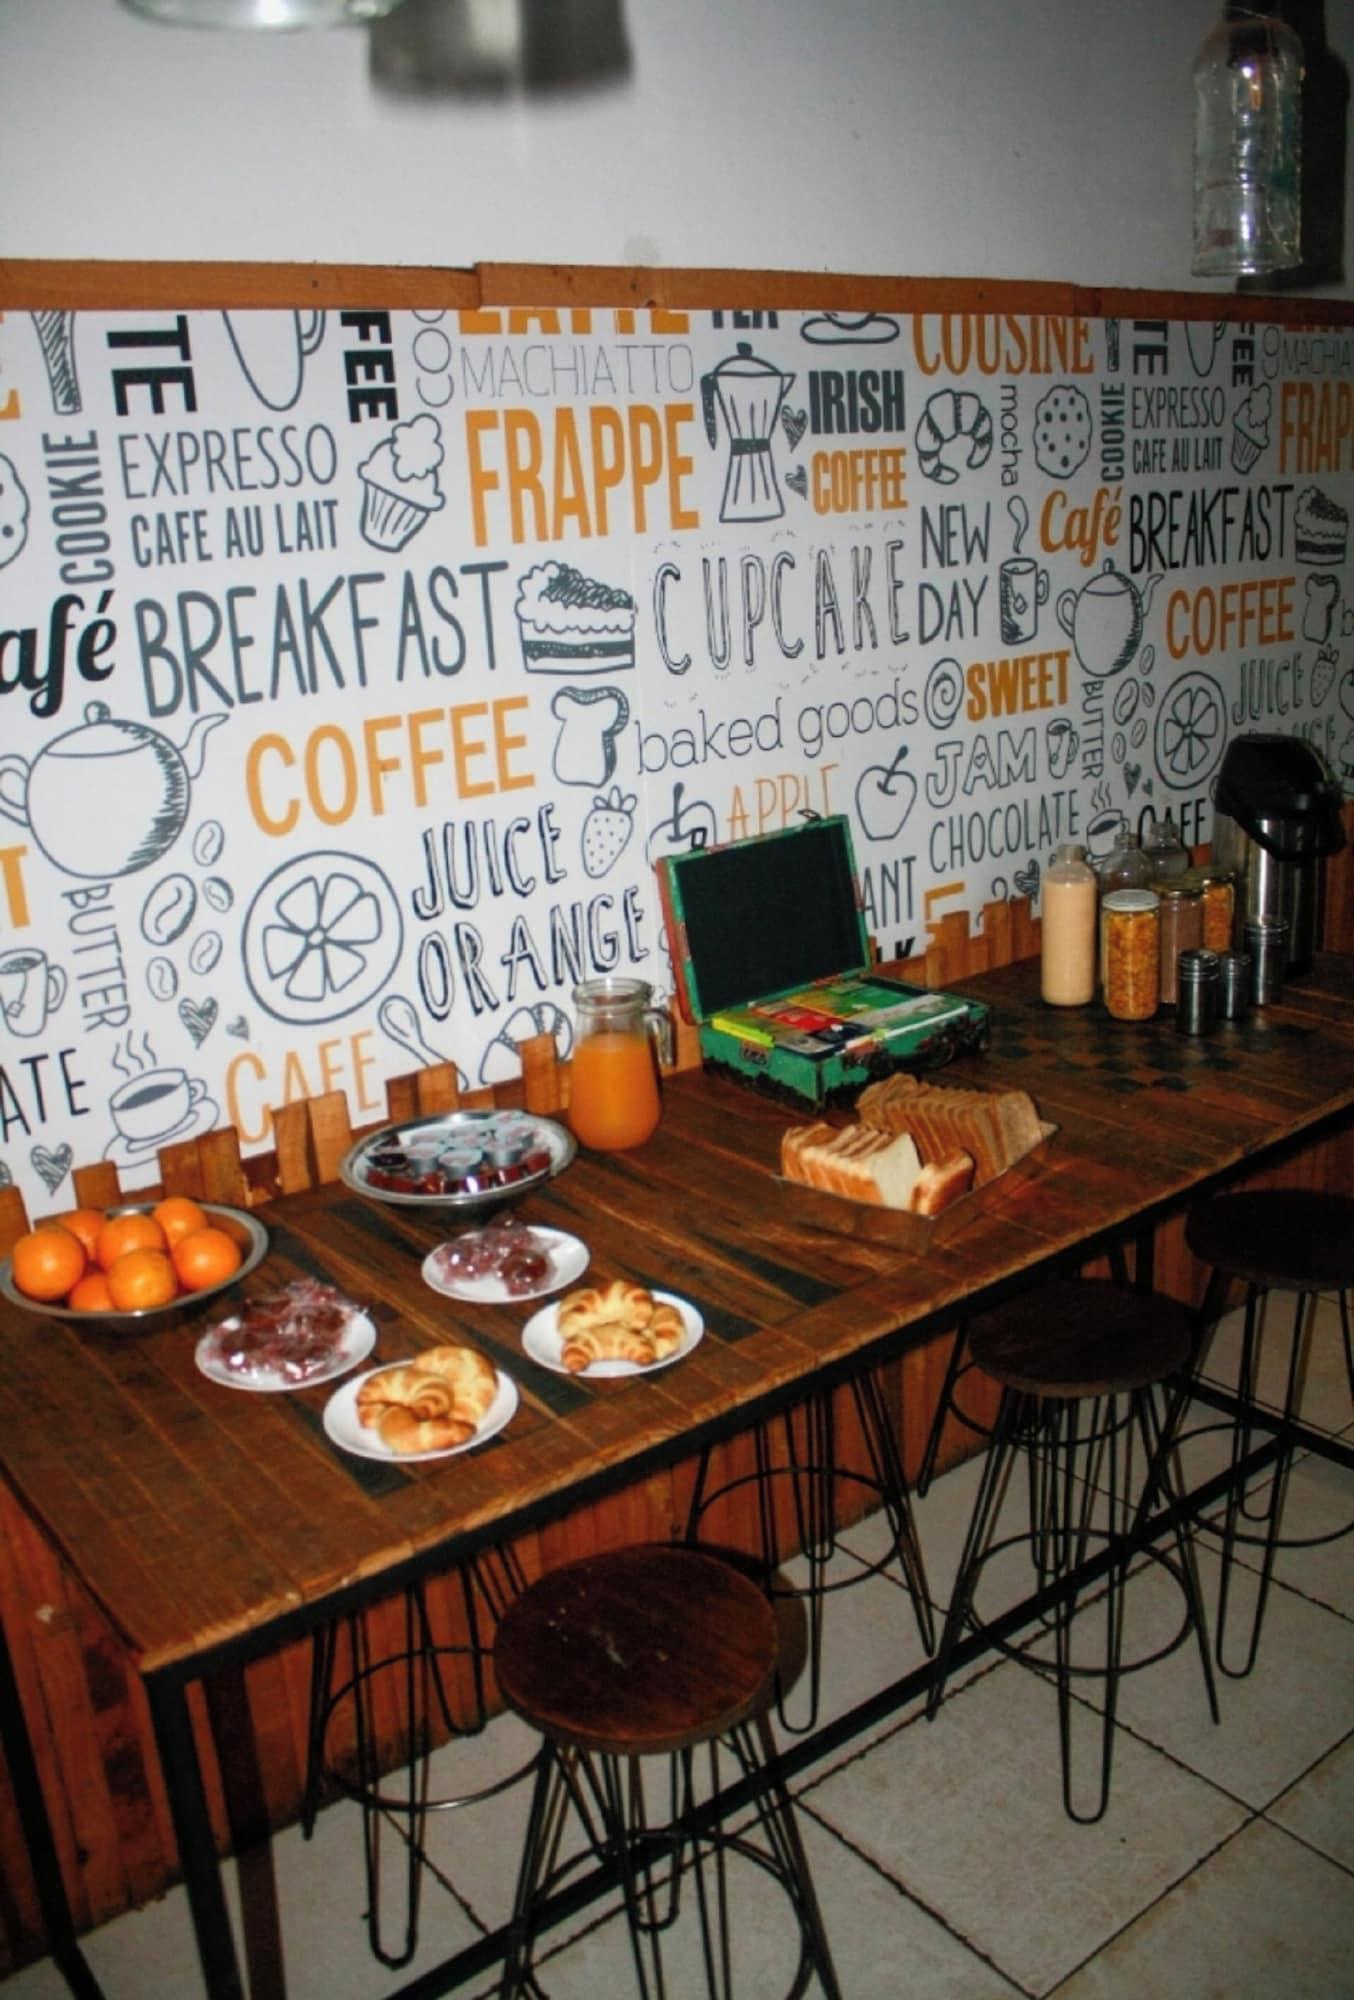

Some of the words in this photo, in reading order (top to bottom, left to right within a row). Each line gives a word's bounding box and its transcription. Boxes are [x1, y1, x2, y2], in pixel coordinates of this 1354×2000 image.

[461, 344, 694, 398] MACHIATTO
[809, 370, 906, 434] IRISH
[1132, 386, 1225, 430] EXPRESSO
[118, 424, 337, 499] EXPRESSO
[1001, 384, 1023, 487] mocha
[1101, 382, 1125, 483] COOKIE
[1132, 439, 1167, 475] CAFE
[1172, 438, 1191, 473] AU
[1194, 437, 1223, 471] LAIT
[1279, 381, 1354, 475] FRAP
[42, 430, 115, 585] COOKIE
[465, 404, 699, 548] FRAPPE
[811, 448, 908, 516] COFFEE
[131, 510, 212, 567] CAFE
[226, 504, 263, 558] AU
[275, 499, 338, 553] LAIT
[921, 502, 990, 568] NEW
[1039, 487, 1123, 568] Café
[1130, 484, 1294, 574] BREAKFAST
[135, 560, 508, 718] BREAKFAST
[653, 540, 910, 676] CUPCAKE
[919, 575, 988, 645] DAY
[1166, 577, 1296, 660] COFFEE
[635, 697, 783, 775] baked
[798, 678, 919, 758] goods
[966, 650, 1071, 723] SWEET
[1231, 651, 1304, 726] JUICE
[246, 695, 535, 837] COFFEE
[926, 727, 1036, 808] JAM
[1081, 682, 1103, 779] BUTTER
[412, 803, 567, 921] JUICE
[930, 788, 1080, 874] CHOCOLATE
[61, 883, 131, 1032] BUTTER
[418, 888, 649, 1022] ORANGE
